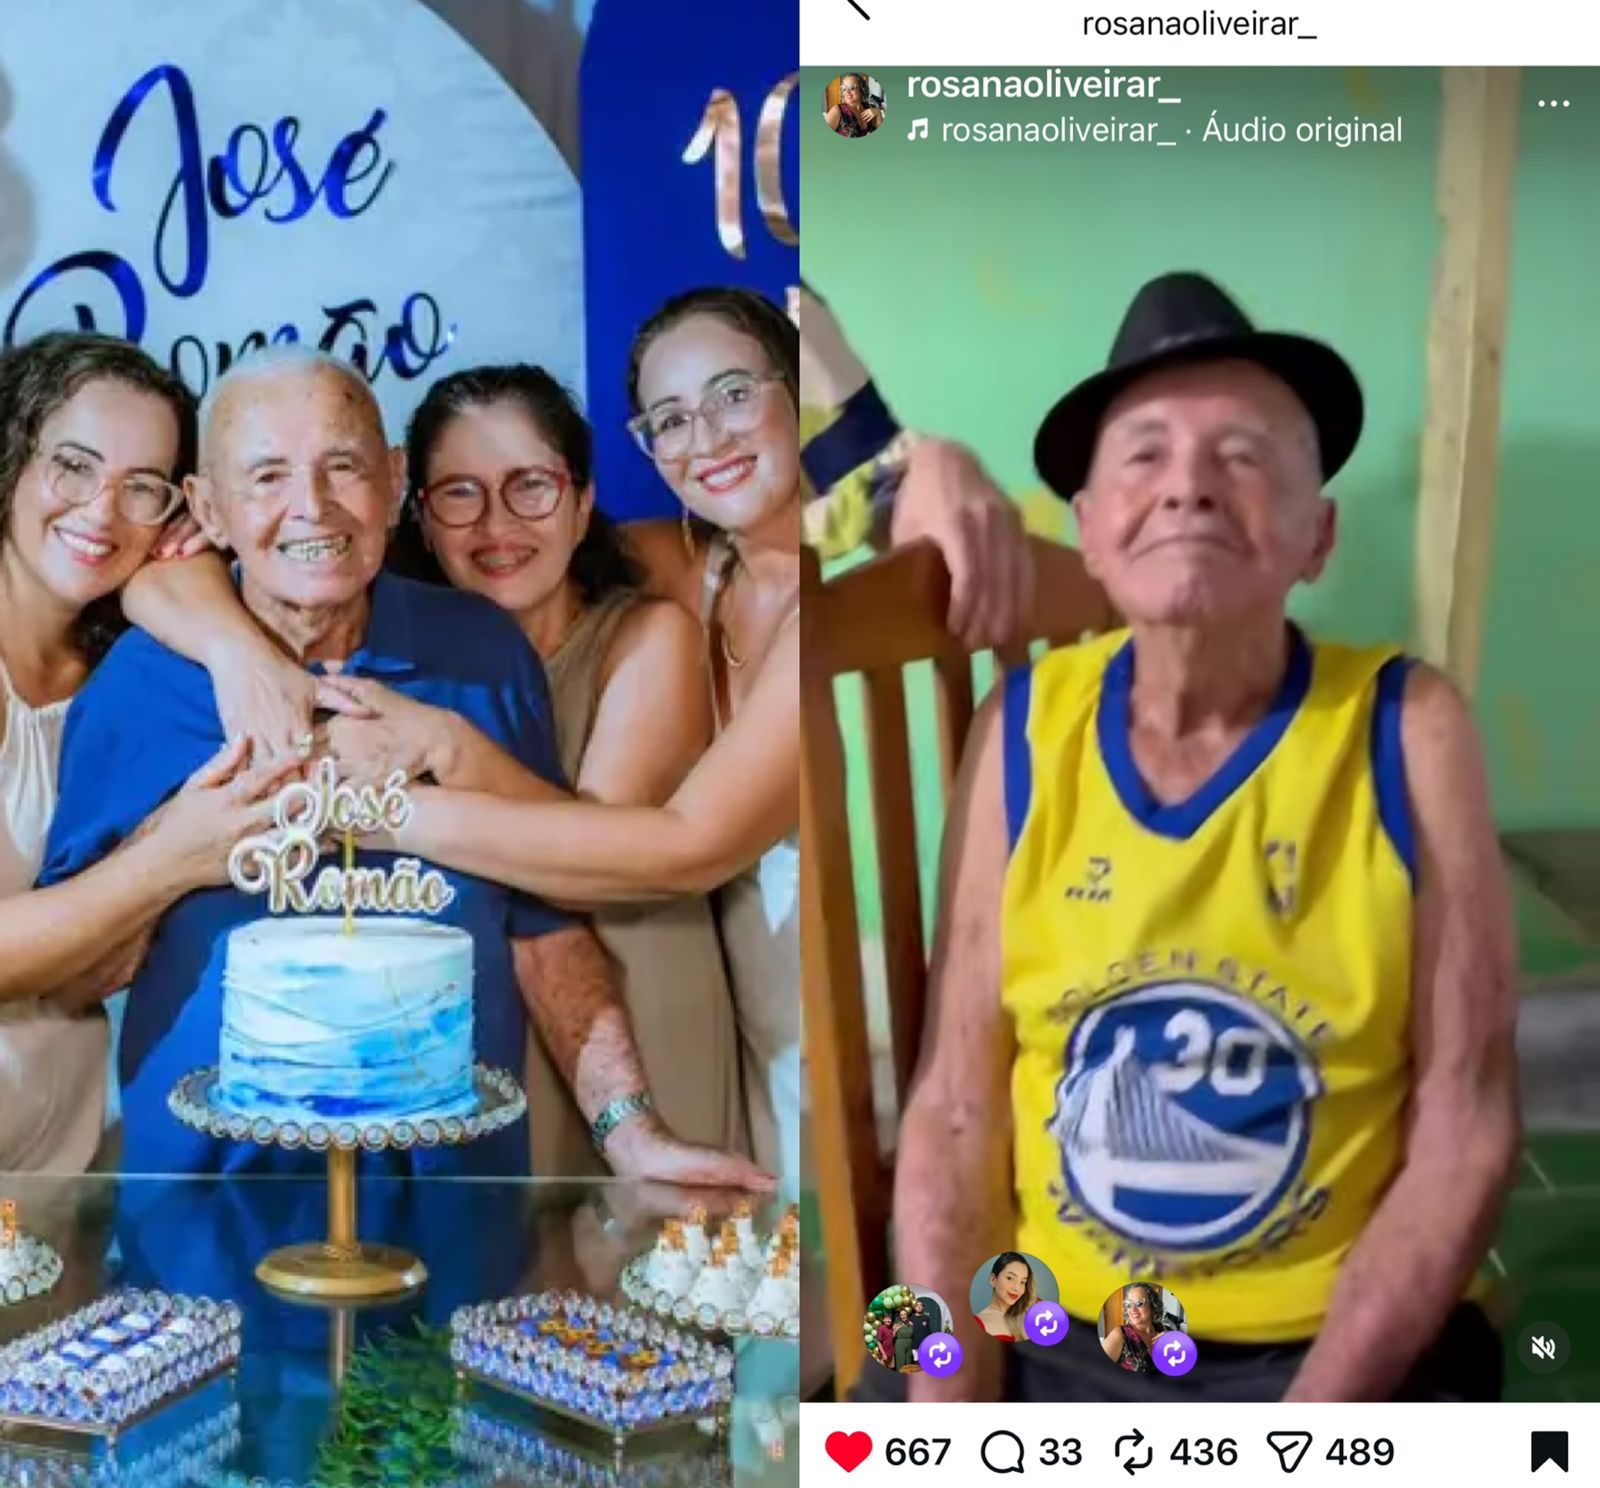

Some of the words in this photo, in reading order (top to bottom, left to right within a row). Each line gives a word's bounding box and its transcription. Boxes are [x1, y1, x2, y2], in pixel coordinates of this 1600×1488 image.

[1082, 10, 1318, 39] rosanaoliveirar_
[907, 69, 1182, 103] rosanaoliveirar_
[942, 116, 1177, 146] rosanaoliveirar_
[1202, 111, 1286, 142] Áudio
[1296, 117, 1403, 147] original
[92, 64, 396, 298] José
[275, 756, 414, 837] José
[228, 832, 456, 914] Romão
[1151, 1007, 1268, 1096] 30
[884, 1437, 952, 1466] 667
[1038, 1437, 1083, 1466] 33
[1169, 1437, 1239, 1466] 436
[1325, 1437, 1395, 1466] 489
